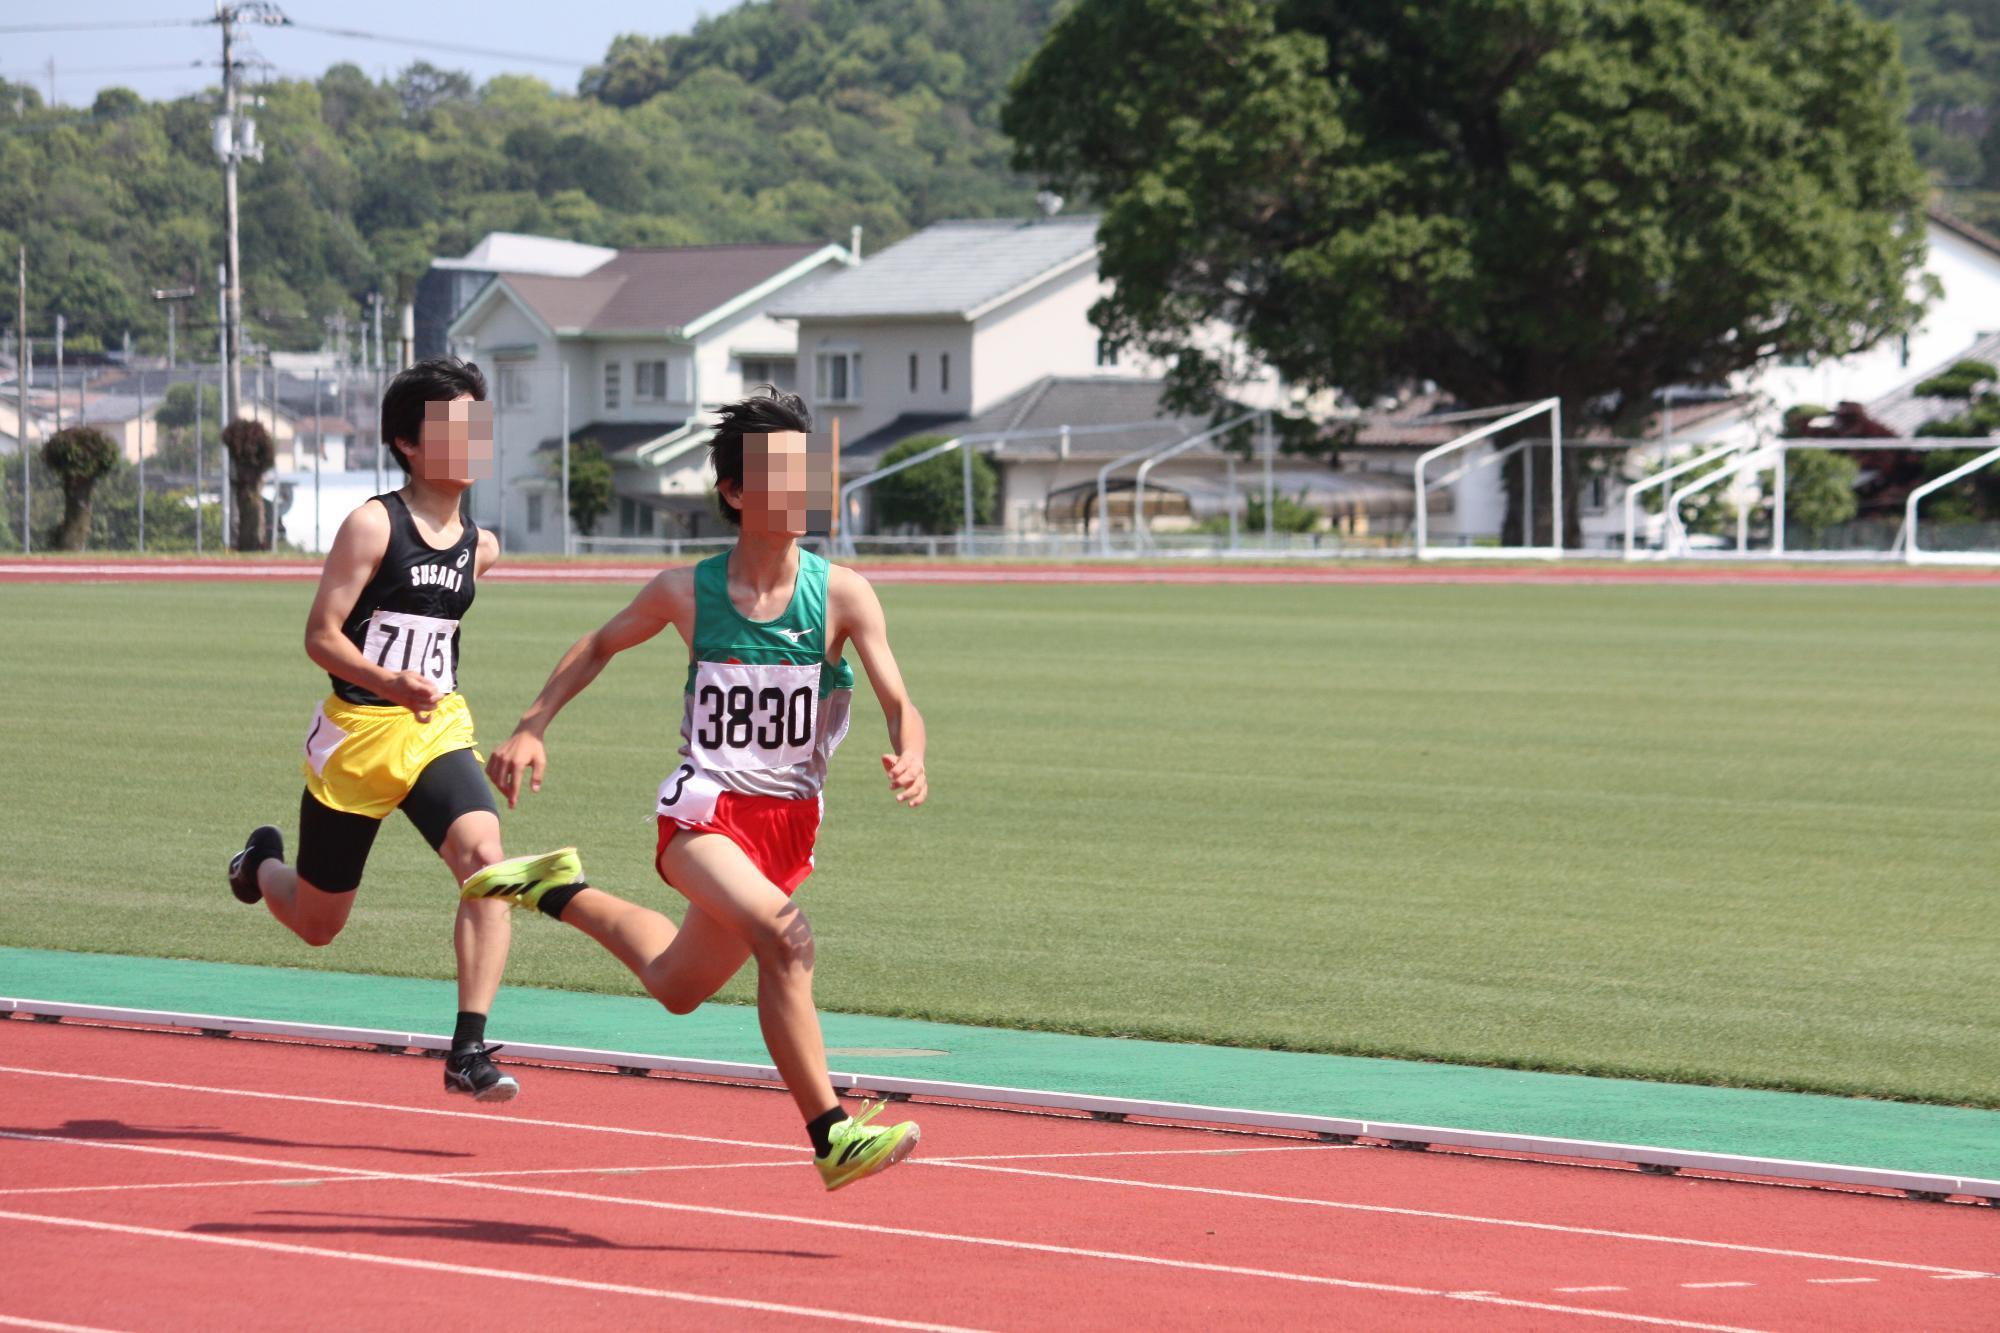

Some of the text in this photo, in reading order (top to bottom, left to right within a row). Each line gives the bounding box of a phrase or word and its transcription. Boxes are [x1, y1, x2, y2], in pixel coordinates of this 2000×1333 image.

[411, 564, 463, 593] SUSAKI
[698, 685, 812, 750] 3830
[661, 764, 695, 807] 3
